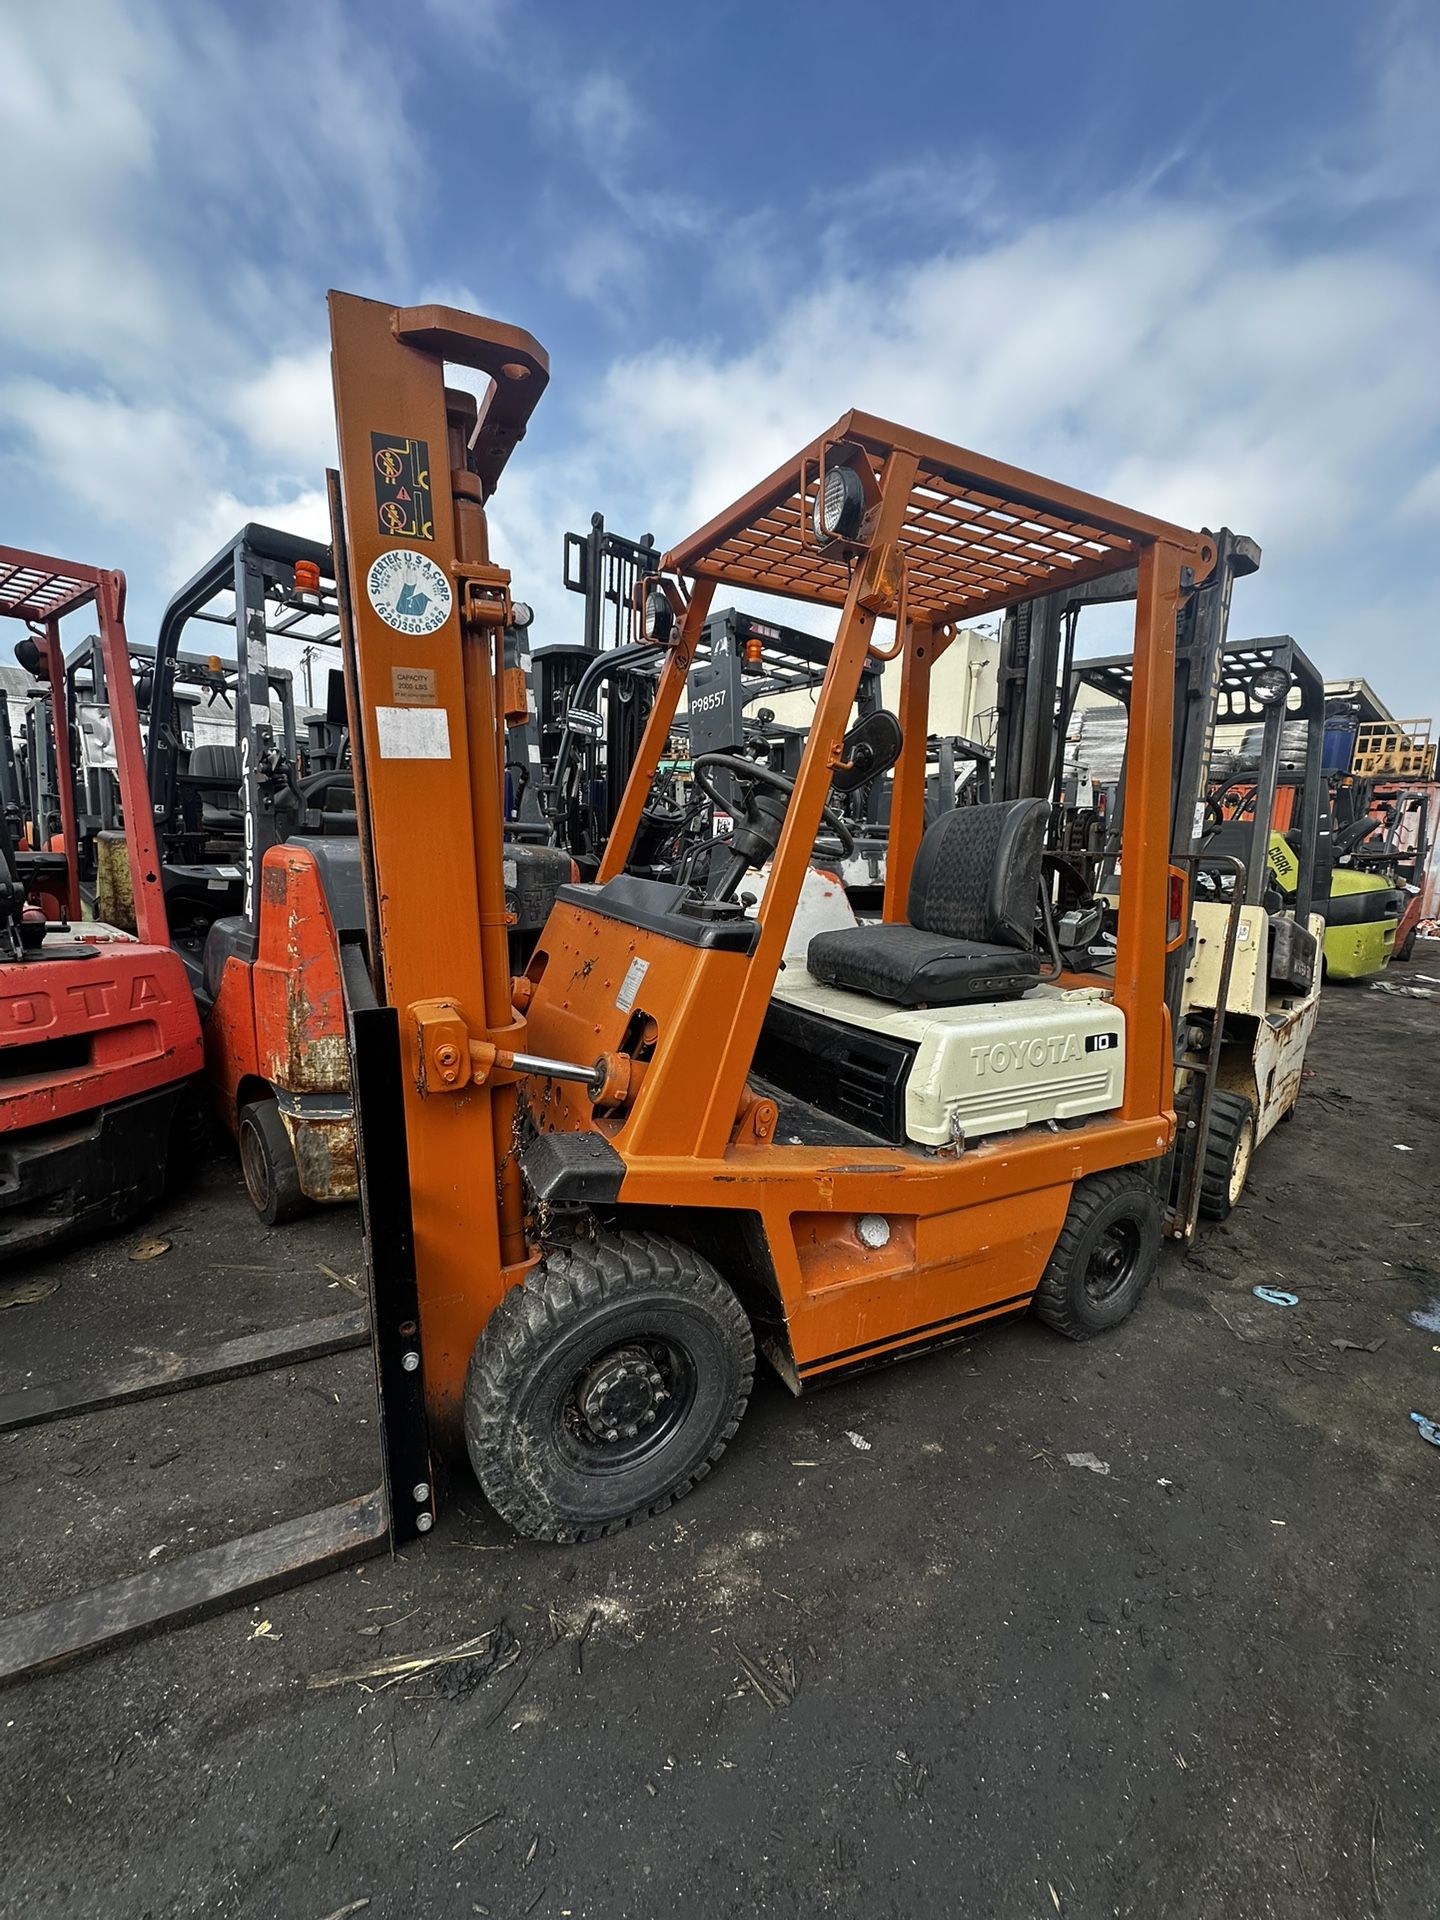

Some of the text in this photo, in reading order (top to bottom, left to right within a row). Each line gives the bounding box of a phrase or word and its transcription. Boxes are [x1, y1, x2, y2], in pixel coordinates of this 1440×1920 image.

[370, 551, 402, 596] SUPERTEK
[404, 552, 412, 563] U
[415, 555, 424, 565] S
[423, 561, 432, 572] A
[432, 570, 450, 602] CORP.
[374, 602, 448, 634] (626)350-6362
[396, 673, 429, 682] CAPACITY
[398, 682, 414, 691] 2000
[691, 689, 726, 715] P98557
[241, 736, 255, 923] 21054
[1268, 846, 1293, 876] CLARK
[970, 1033, 1110, 1076] TOYOTA 10
